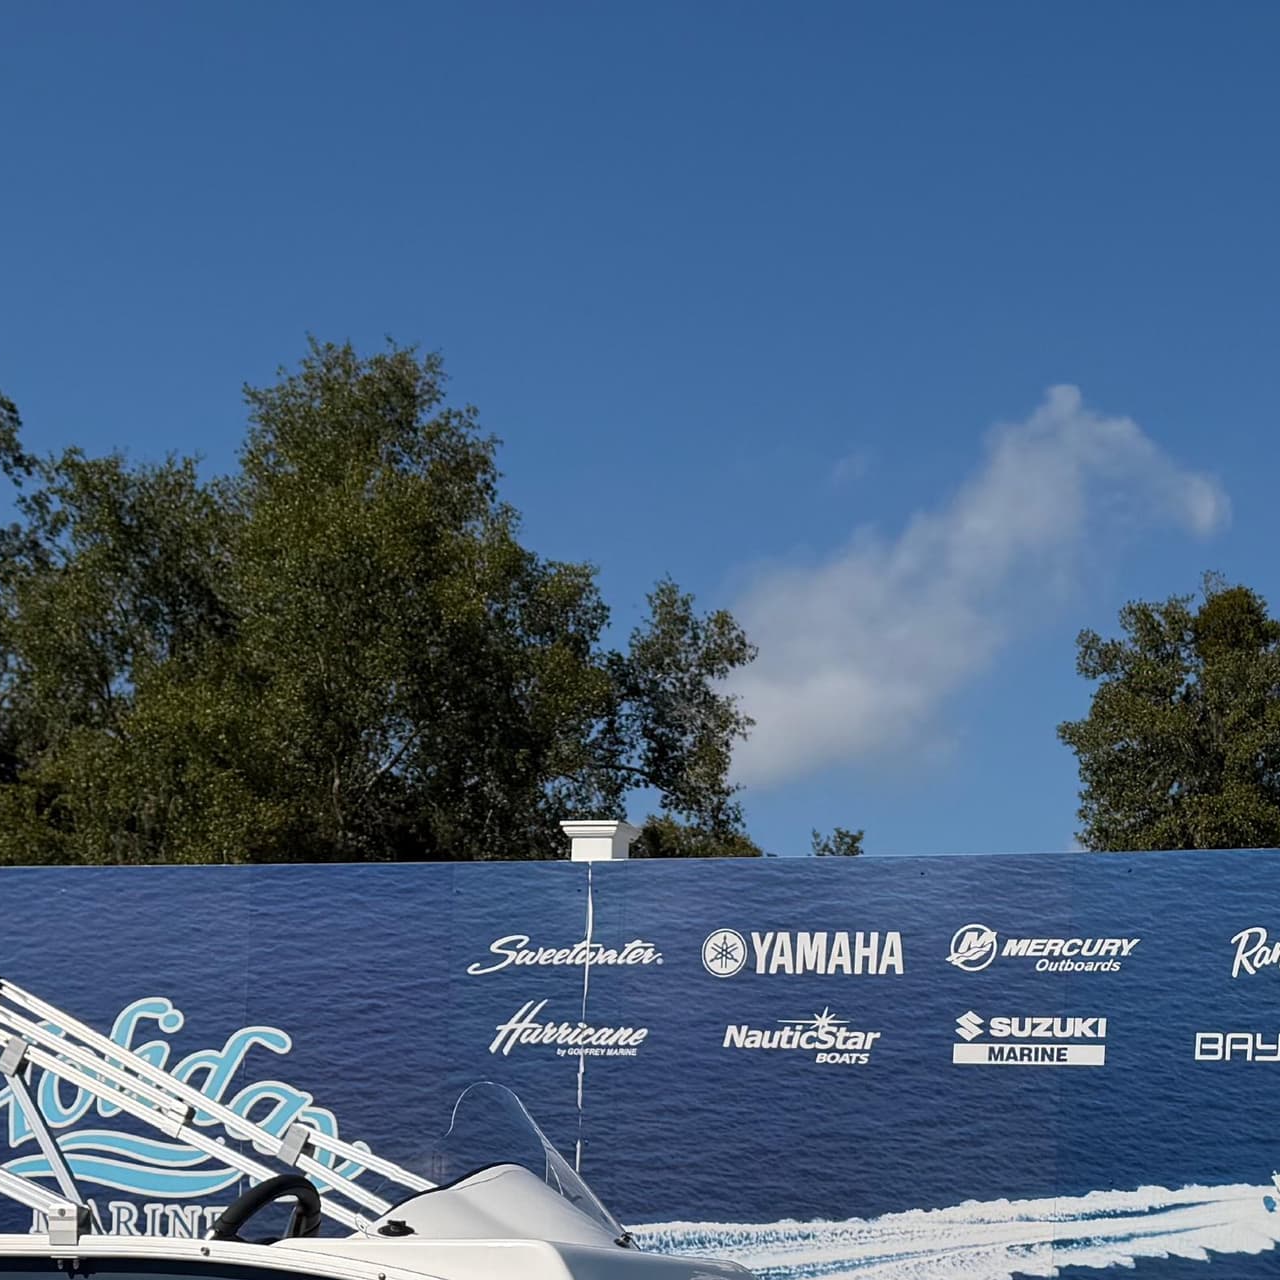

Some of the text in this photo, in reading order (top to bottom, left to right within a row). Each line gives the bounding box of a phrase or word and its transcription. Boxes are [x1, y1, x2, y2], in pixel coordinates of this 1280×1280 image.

[467, 934, 655, 975] Sweetwater
[751, 931, 904, 975] YAMAHA
[1001, 938, 1141, 957] MERCURY
[1035, 958, 1121, 972] Outboards
[488, 998, 650, 1056] Hurricane
[989, 1017, 1107, 1038] SUZUKI
[556, 1047, 567, 1058] by
[606, 1047, 638, 1057] MARINE
[815, 1052, 870, 1065] BOATS
[987, 1046, 1069, 1063] MARINE
